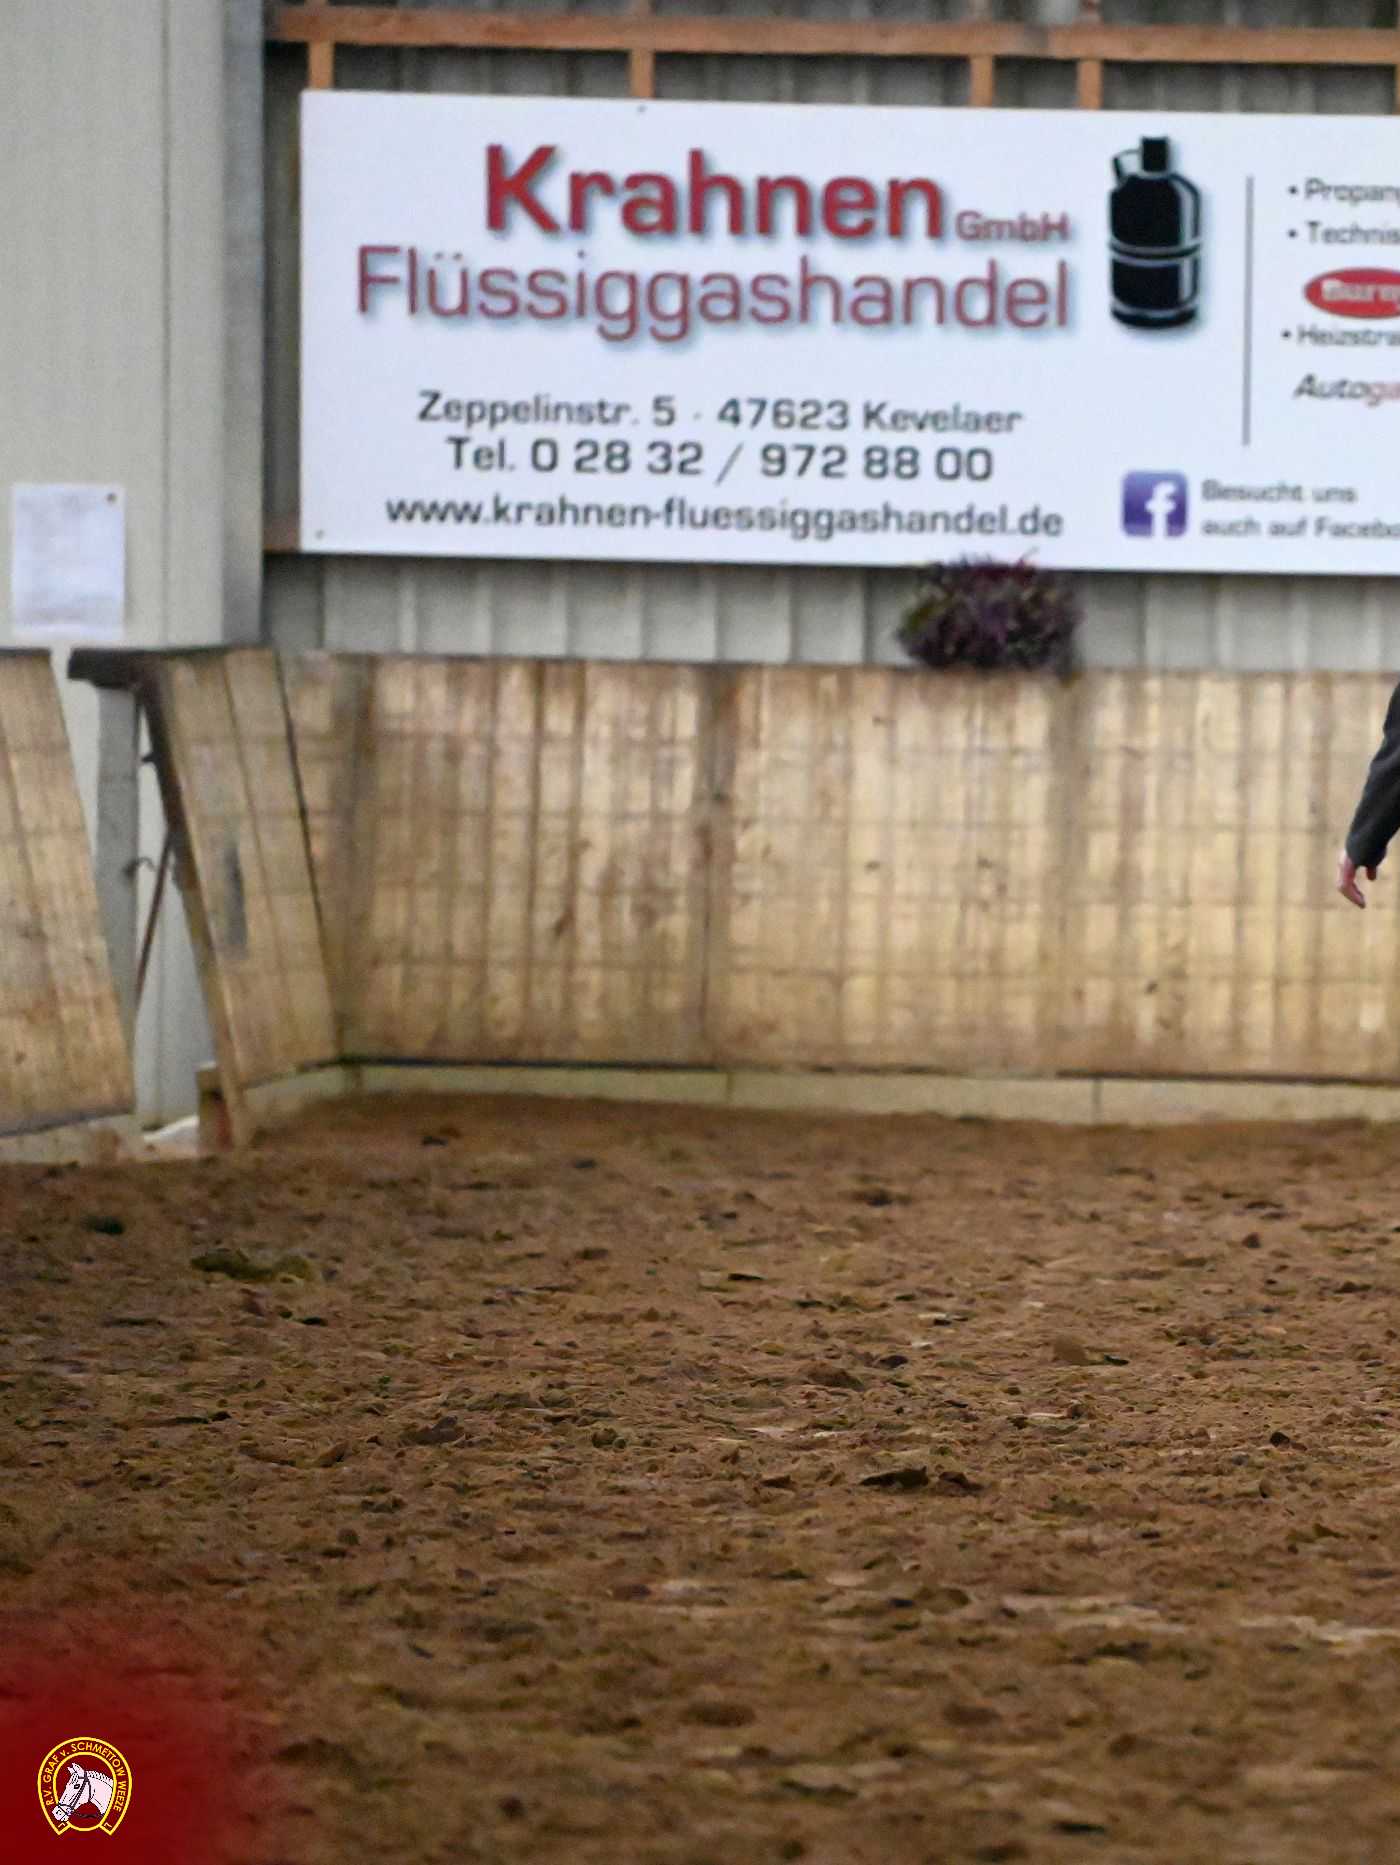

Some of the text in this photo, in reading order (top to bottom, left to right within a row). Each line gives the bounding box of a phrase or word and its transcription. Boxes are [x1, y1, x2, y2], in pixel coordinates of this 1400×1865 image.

[486, 142, 1069, 242] Krahnen GmbH
[357, 245, 1068, 342] Flüssiggashandel
[418, 389, 1022, 434] Zeppelinstr. 5 47623 Kevelaer
[447, 435, 994, 486] Tel. 0 28 32 / 972 88 00
[1201, 479, 1358, 502] Besucht uns
[386, 493, 1064, 542] www.krahnen-fluessiggashandel.de
[1201, 516, 1261, 537] auch
[1268, 516, 1307, 538] auf
